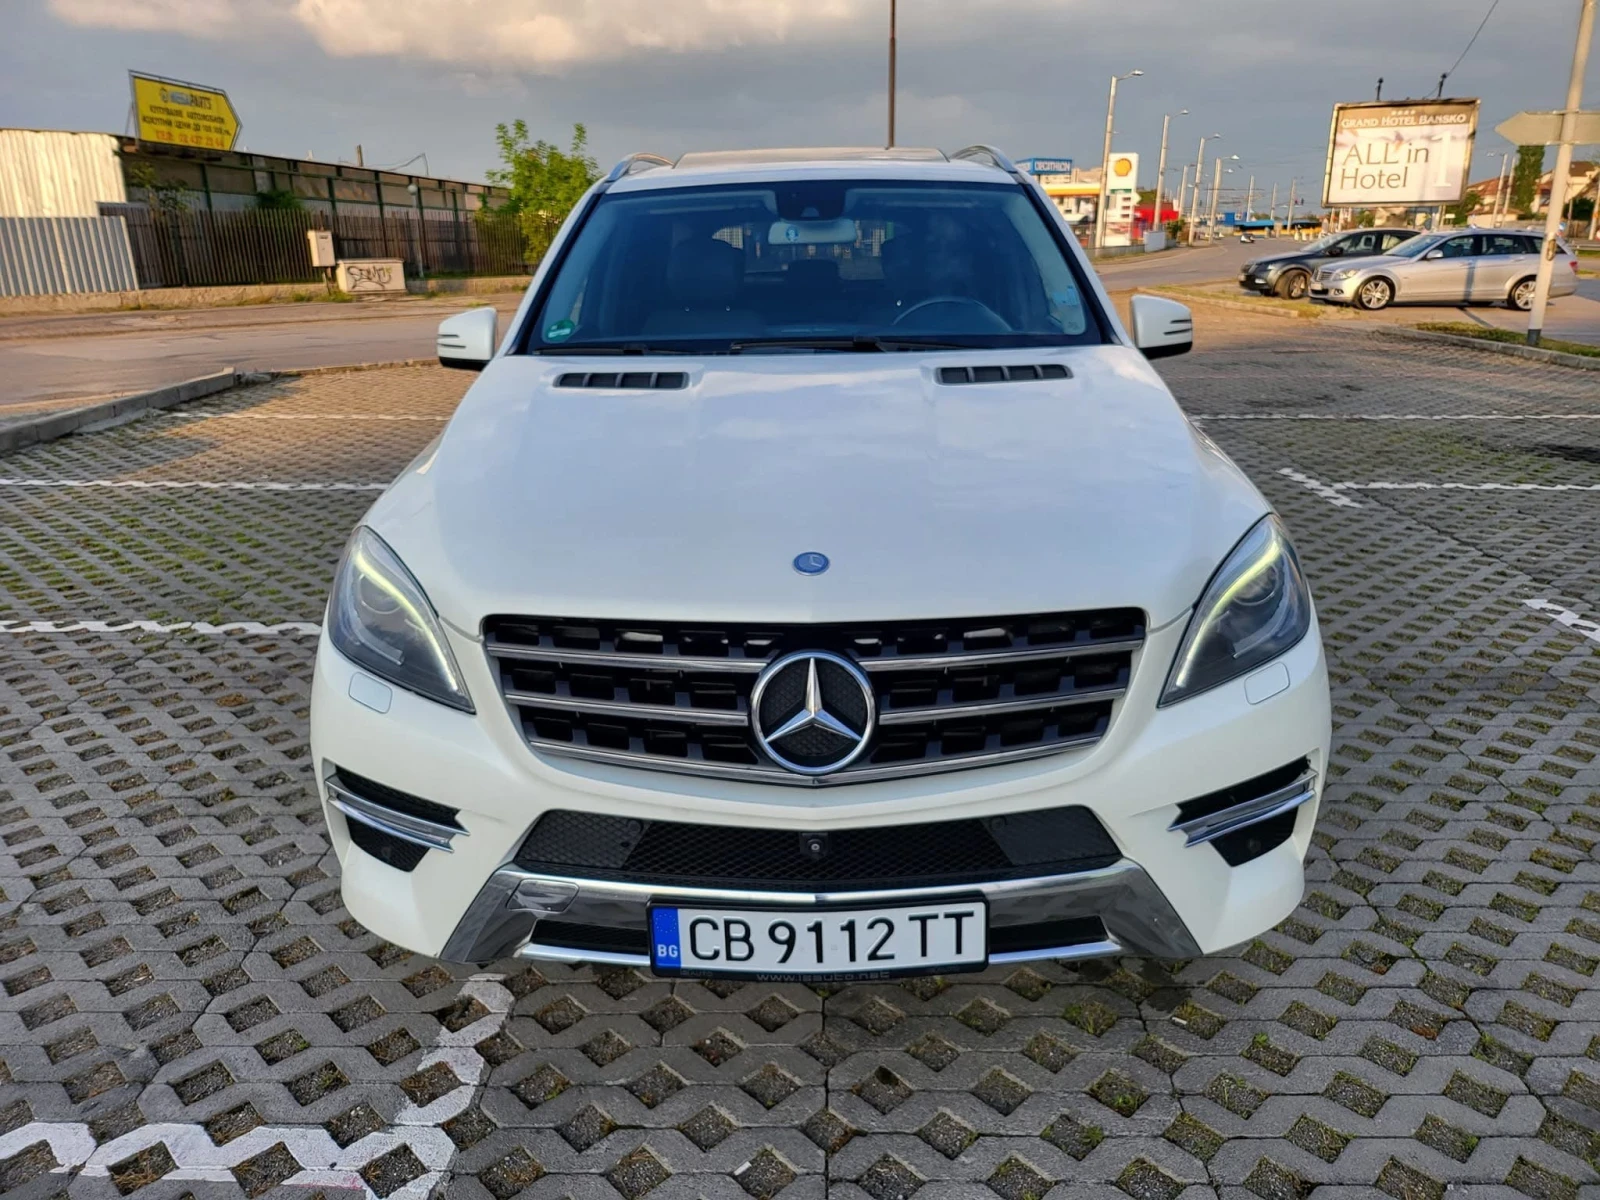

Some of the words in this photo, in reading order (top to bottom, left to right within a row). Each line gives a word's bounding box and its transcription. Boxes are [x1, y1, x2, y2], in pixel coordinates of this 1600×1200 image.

[1341, 117, 1378, 128] GRAND
[1381, 116, 1416, 127] HOTEL
[1418, 113, 1467, 125] BANSKO
[1342, 142, 1399, 166] ALL
[1406, 142, 1430, 164] in
[1340, 166, 1409, 190] Hotel
[690, 916, 755, 962] CB
[768, 916, 895, 964] 9112
[908, 911, 975, 958] TT
[657, 944, 679, 958] BG
